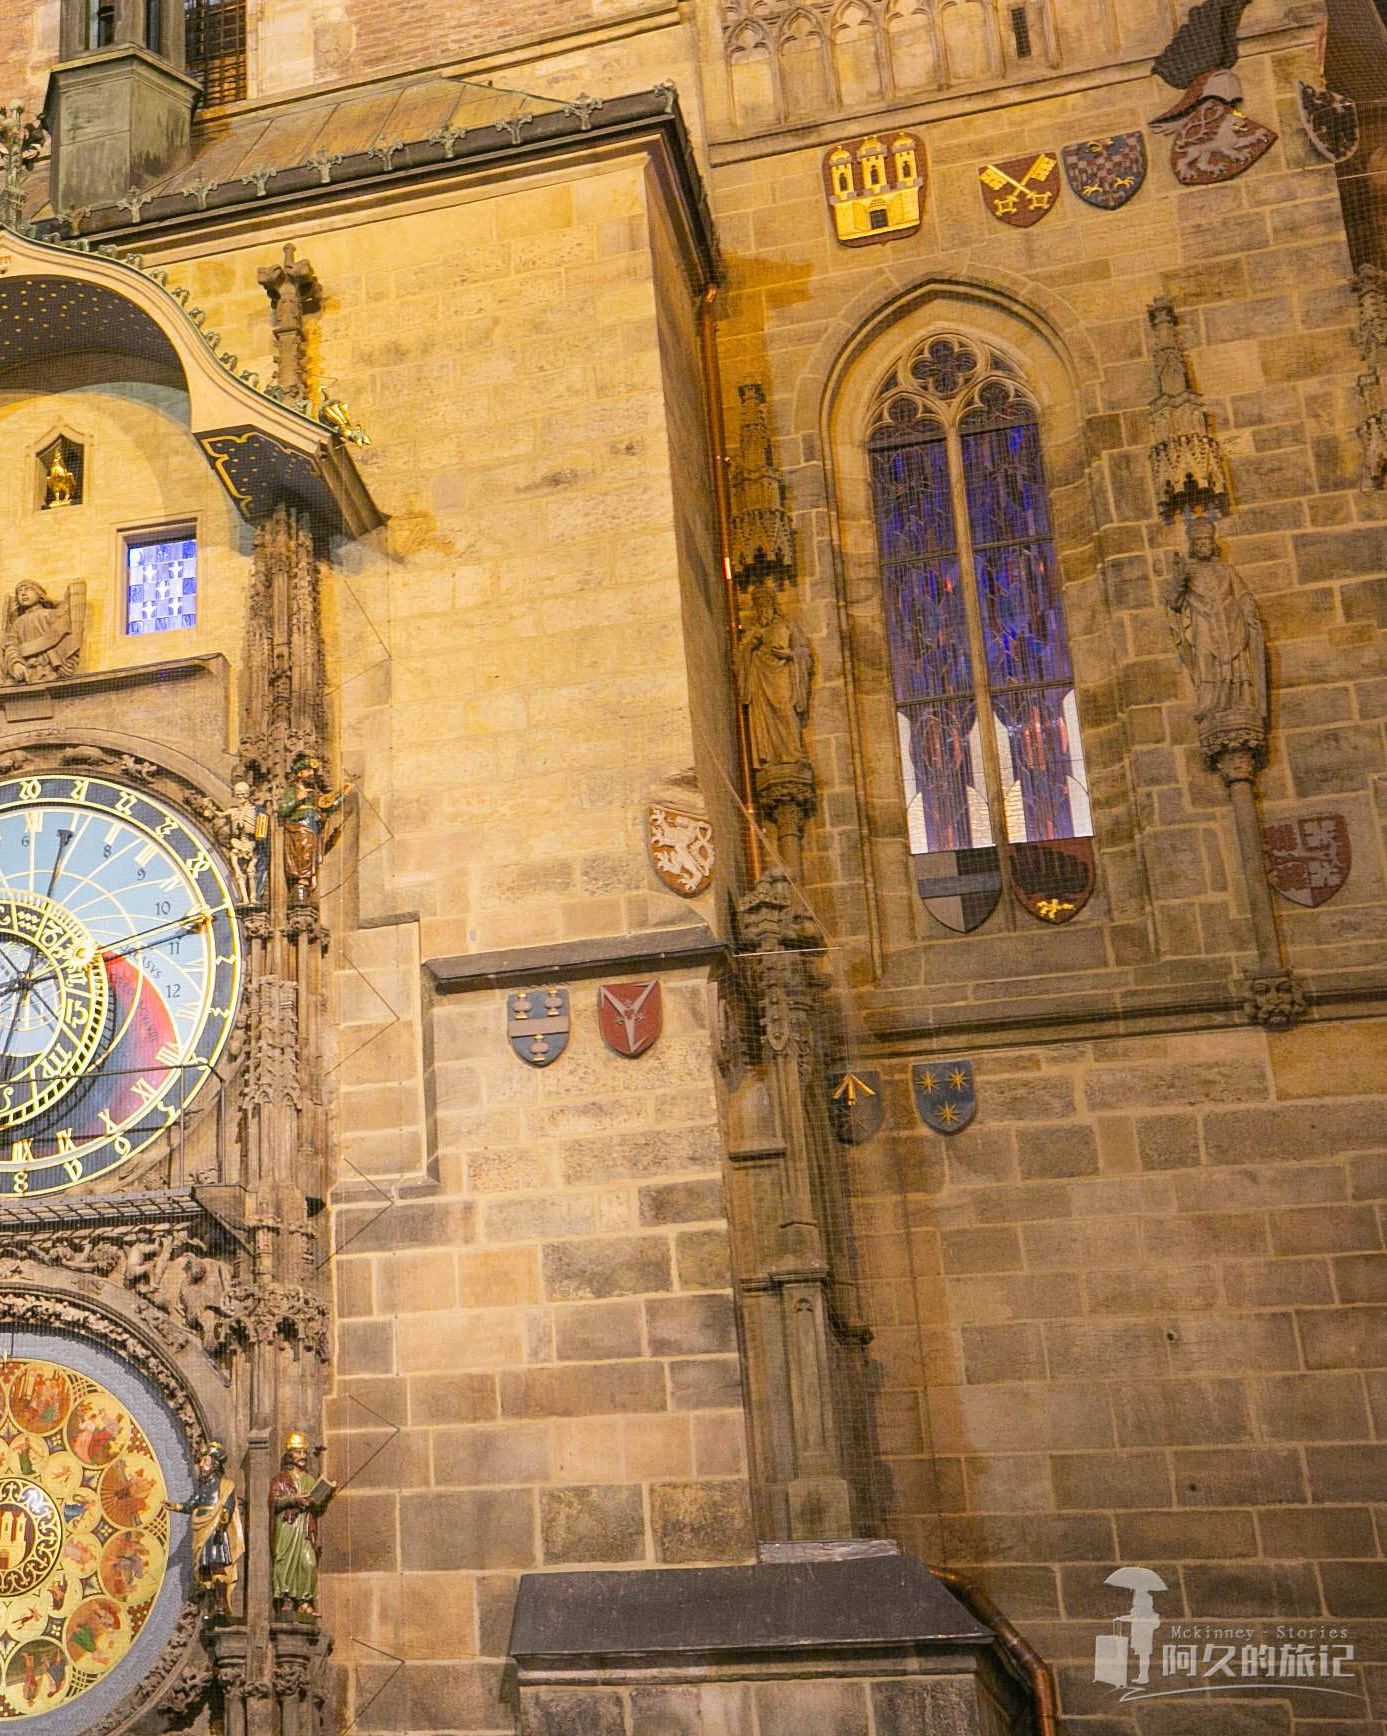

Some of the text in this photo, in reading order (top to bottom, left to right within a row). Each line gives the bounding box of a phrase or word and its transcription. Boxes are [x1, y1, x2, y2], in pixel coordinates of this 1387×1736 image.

[21, 835, 30, 847] 6
[103, 844, 112, 858] 8
[136, 868, 146, 881] 9
[154, 900, 171, 916] 10
[168, 940, 181, 955] 11
[166, 984, 181, 998] 12
[13, 1171, 29, 1193] 8
